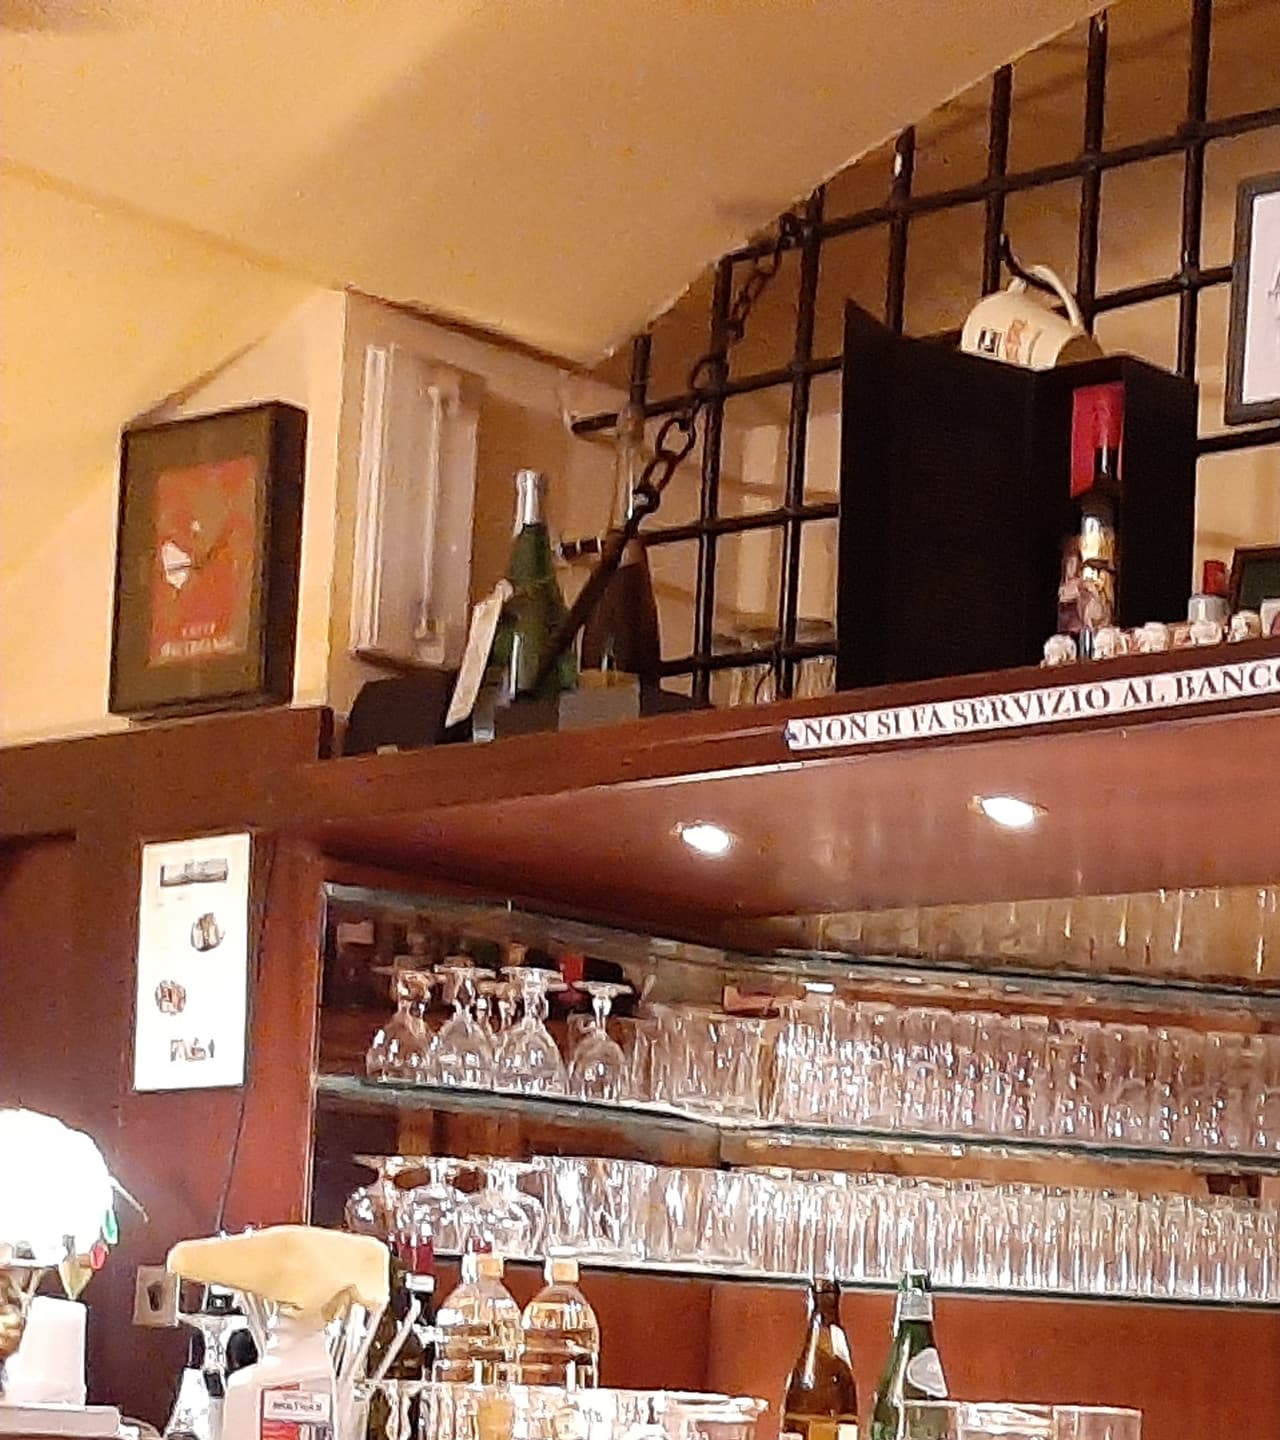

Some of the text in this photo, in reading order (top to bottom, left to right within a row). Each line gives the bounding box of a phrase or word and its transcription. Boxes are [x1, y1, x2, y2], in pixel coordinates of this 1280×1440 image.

[802, 713, 868, 745] NON
[876, 709, 902, 735] SI
[910, 701, 945, 730] FA
[953, 682, 1112, 727] SERVIZIO
[1121, 678, 1165, 706] AL
